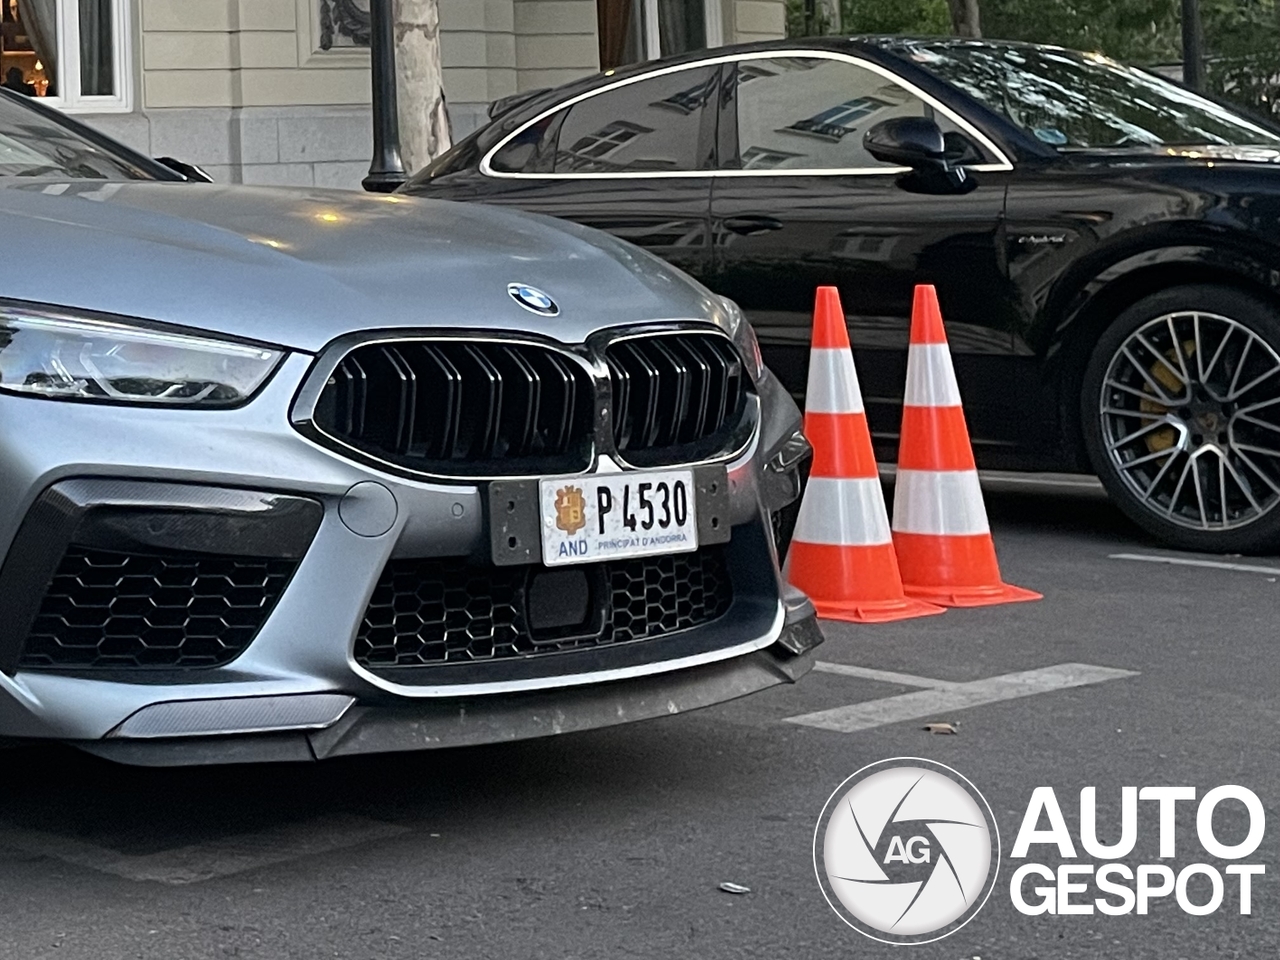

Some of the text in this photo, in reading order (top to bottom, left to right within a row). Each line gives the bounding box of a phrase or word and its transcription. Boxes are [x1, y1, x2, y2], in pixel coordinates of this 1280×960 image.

[596, 480, 687, 535] P 4530
[558, 539, 588, 557] AND
[598, 533, 688, 550] PRINCIPAT D'ANDORRA
